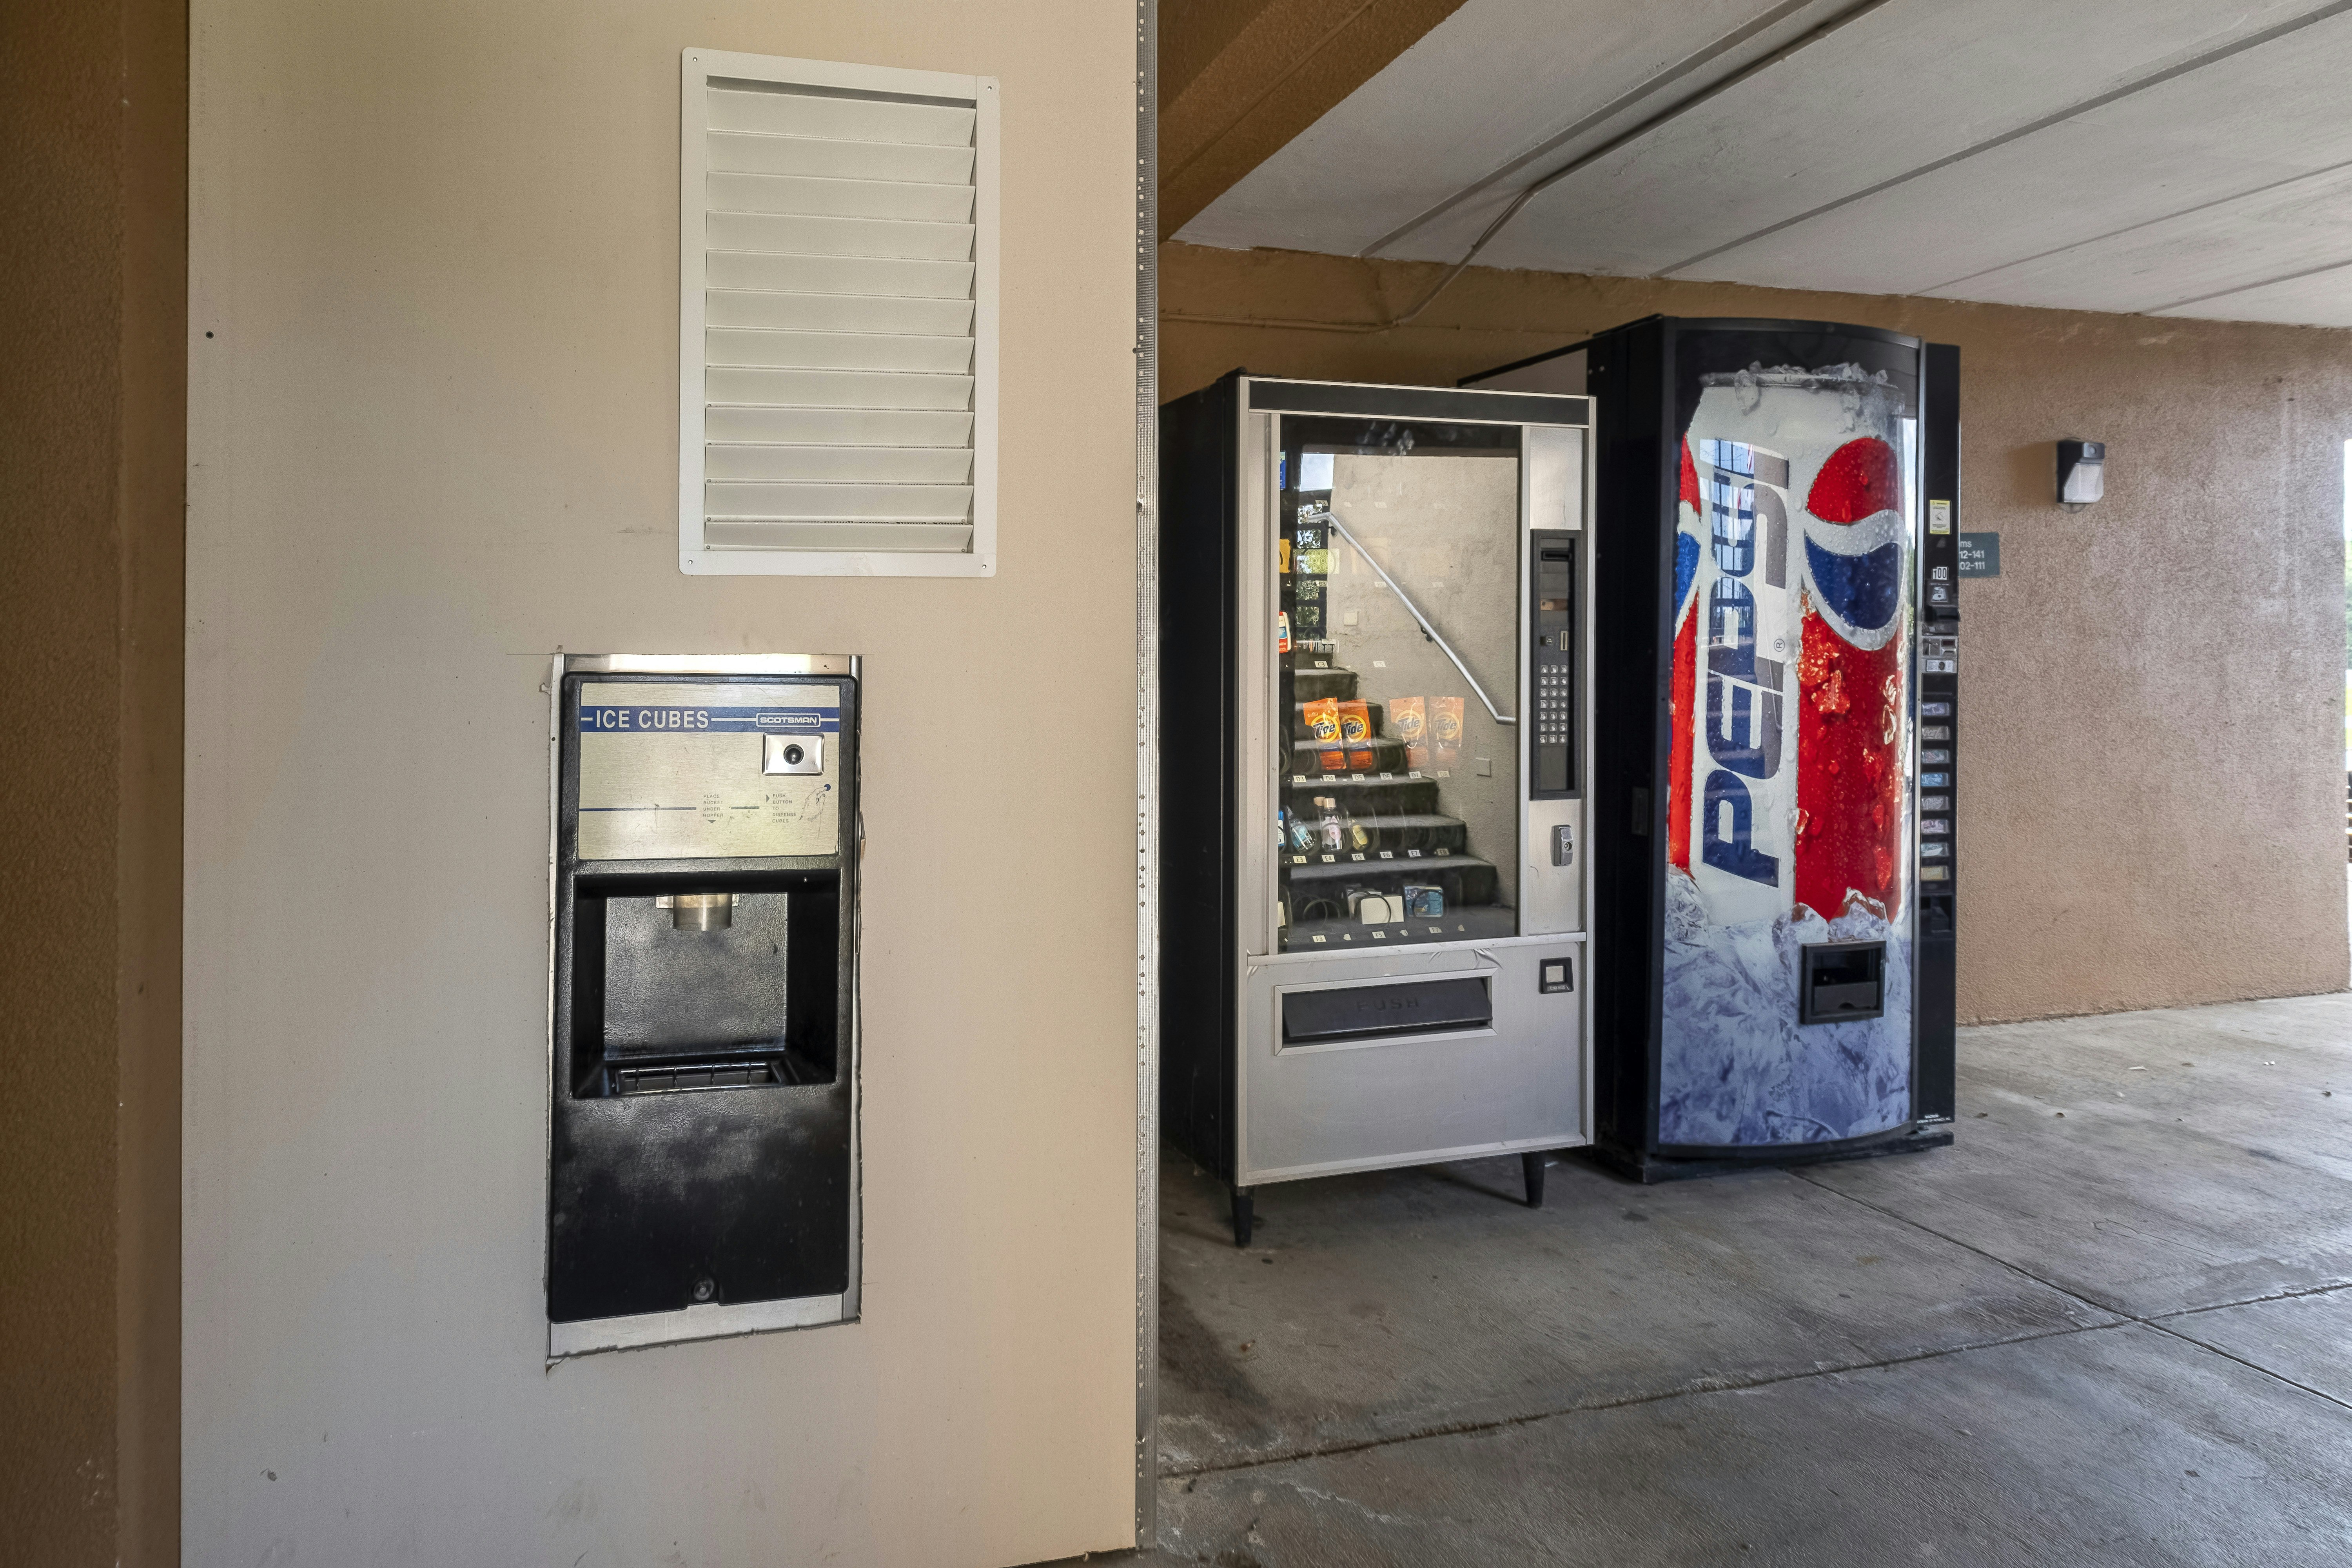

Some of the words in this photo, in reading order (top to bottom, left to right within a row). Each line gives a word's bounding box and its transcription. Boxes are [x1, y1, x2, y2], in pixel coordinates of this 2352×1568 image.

[1960, 550, 1985, 559] 12-141
[1960, 561, 1985, 570] 02-111
[1933, 568, 1947, 579] 100
[1702, 438, 1789, 888] PEPSI
[596, 710, 630, 728] ICE
[639, 710, 709, 728] CUBES
[1398, 717, 1420, 731] Tide
[1436, 718, 1457, 731] Tide
[1357, 997, 1419, 1014] PUSH
